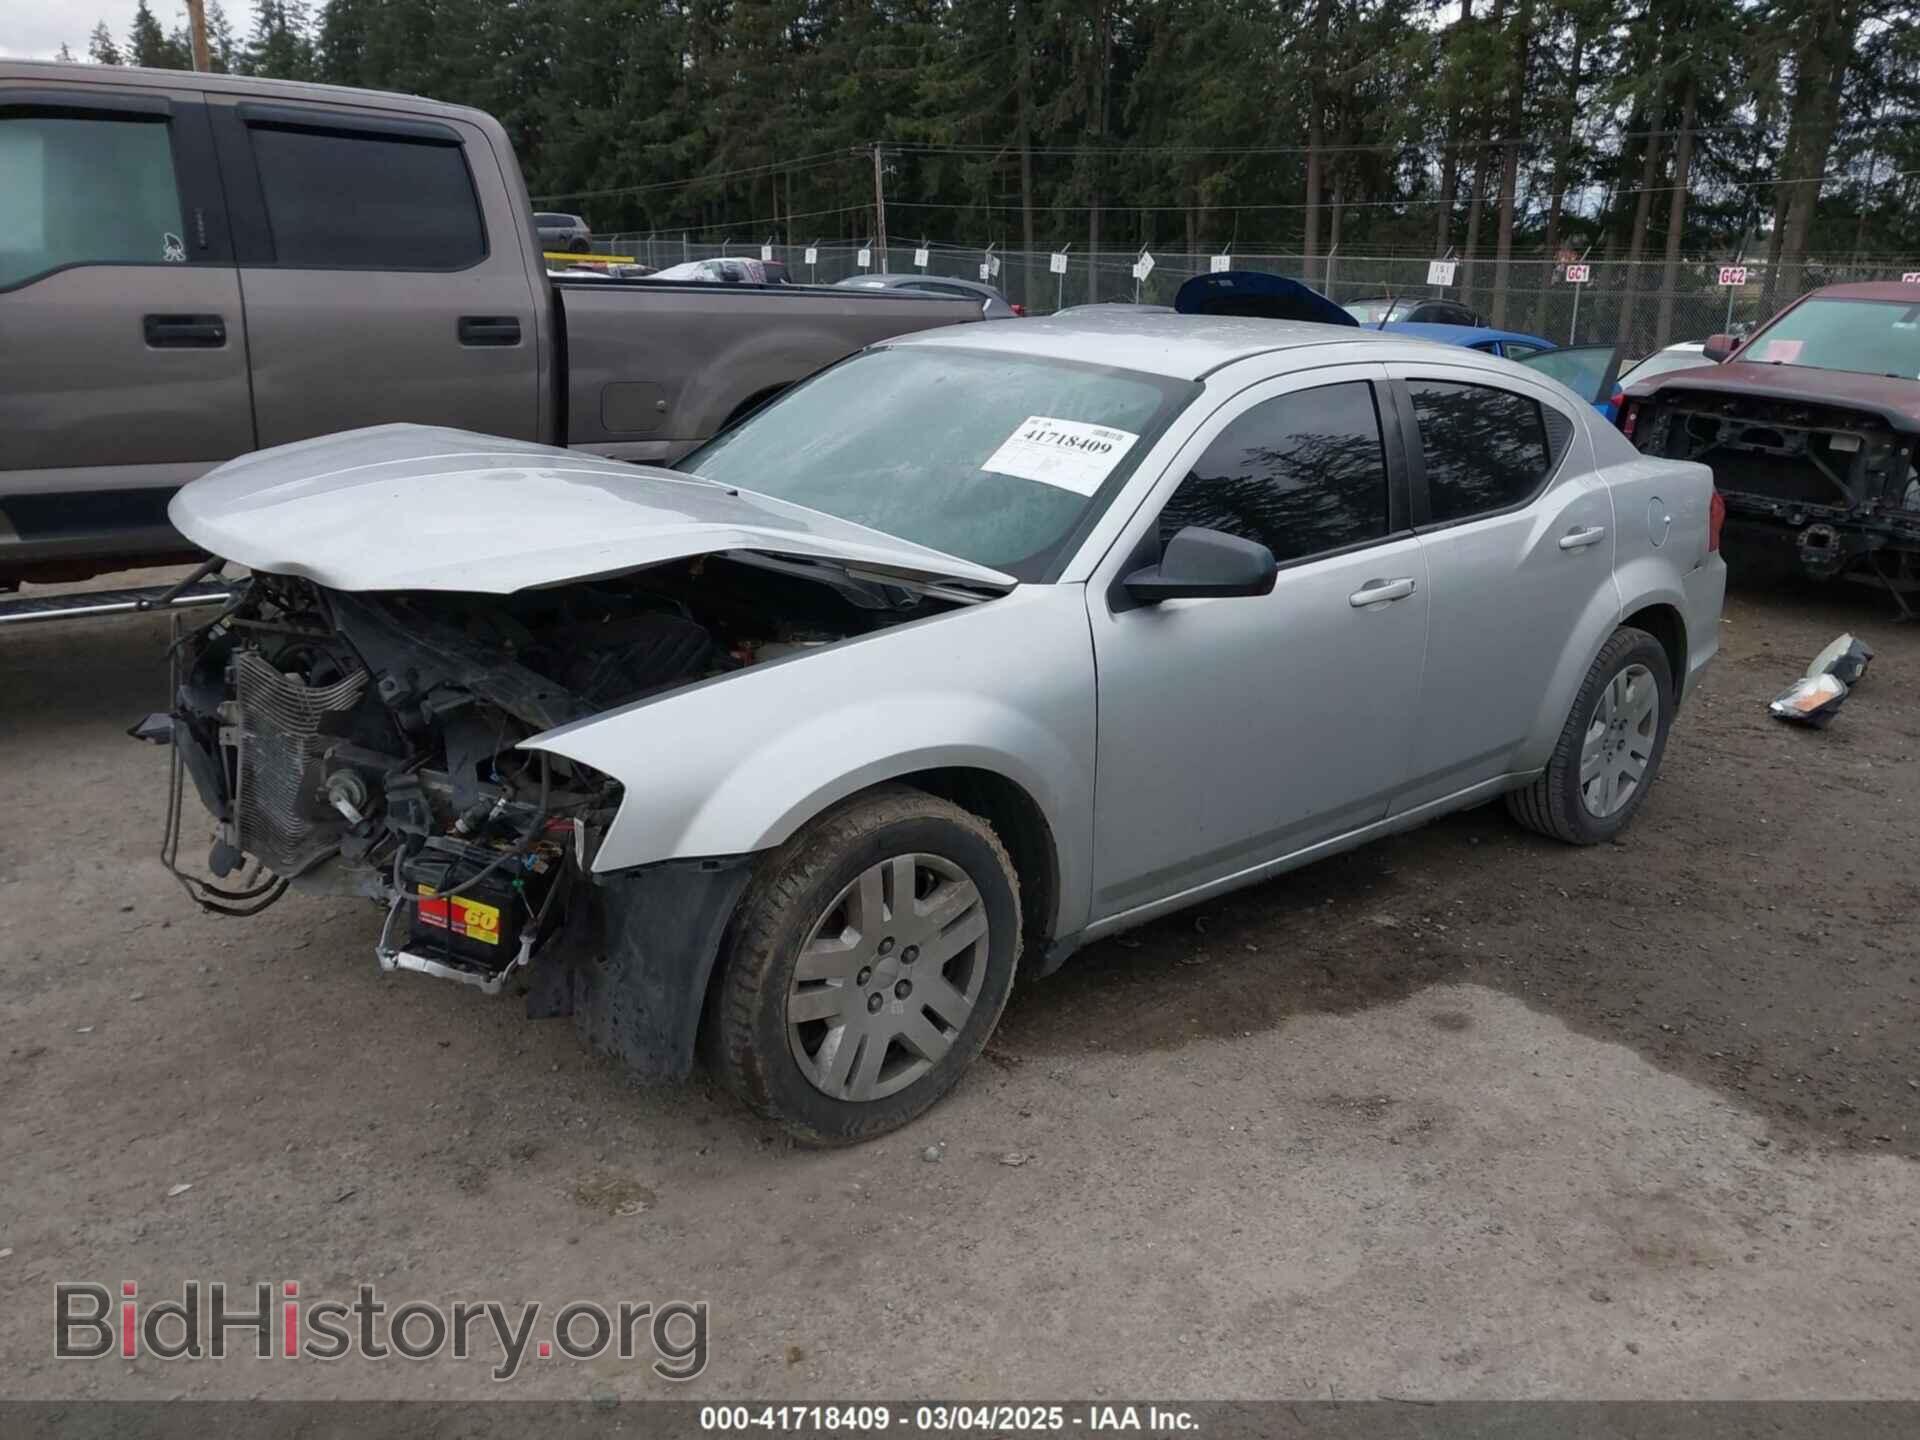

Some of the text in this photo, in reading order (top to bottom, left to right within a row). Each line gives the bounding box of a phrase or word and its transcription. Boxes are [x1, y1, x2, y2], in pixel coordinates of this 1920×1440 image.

[1568, 266, 1586, 280] GC1
[1721, 269, 1744, 283] GC2
[1024, 430, 1112, 454] 41718409
